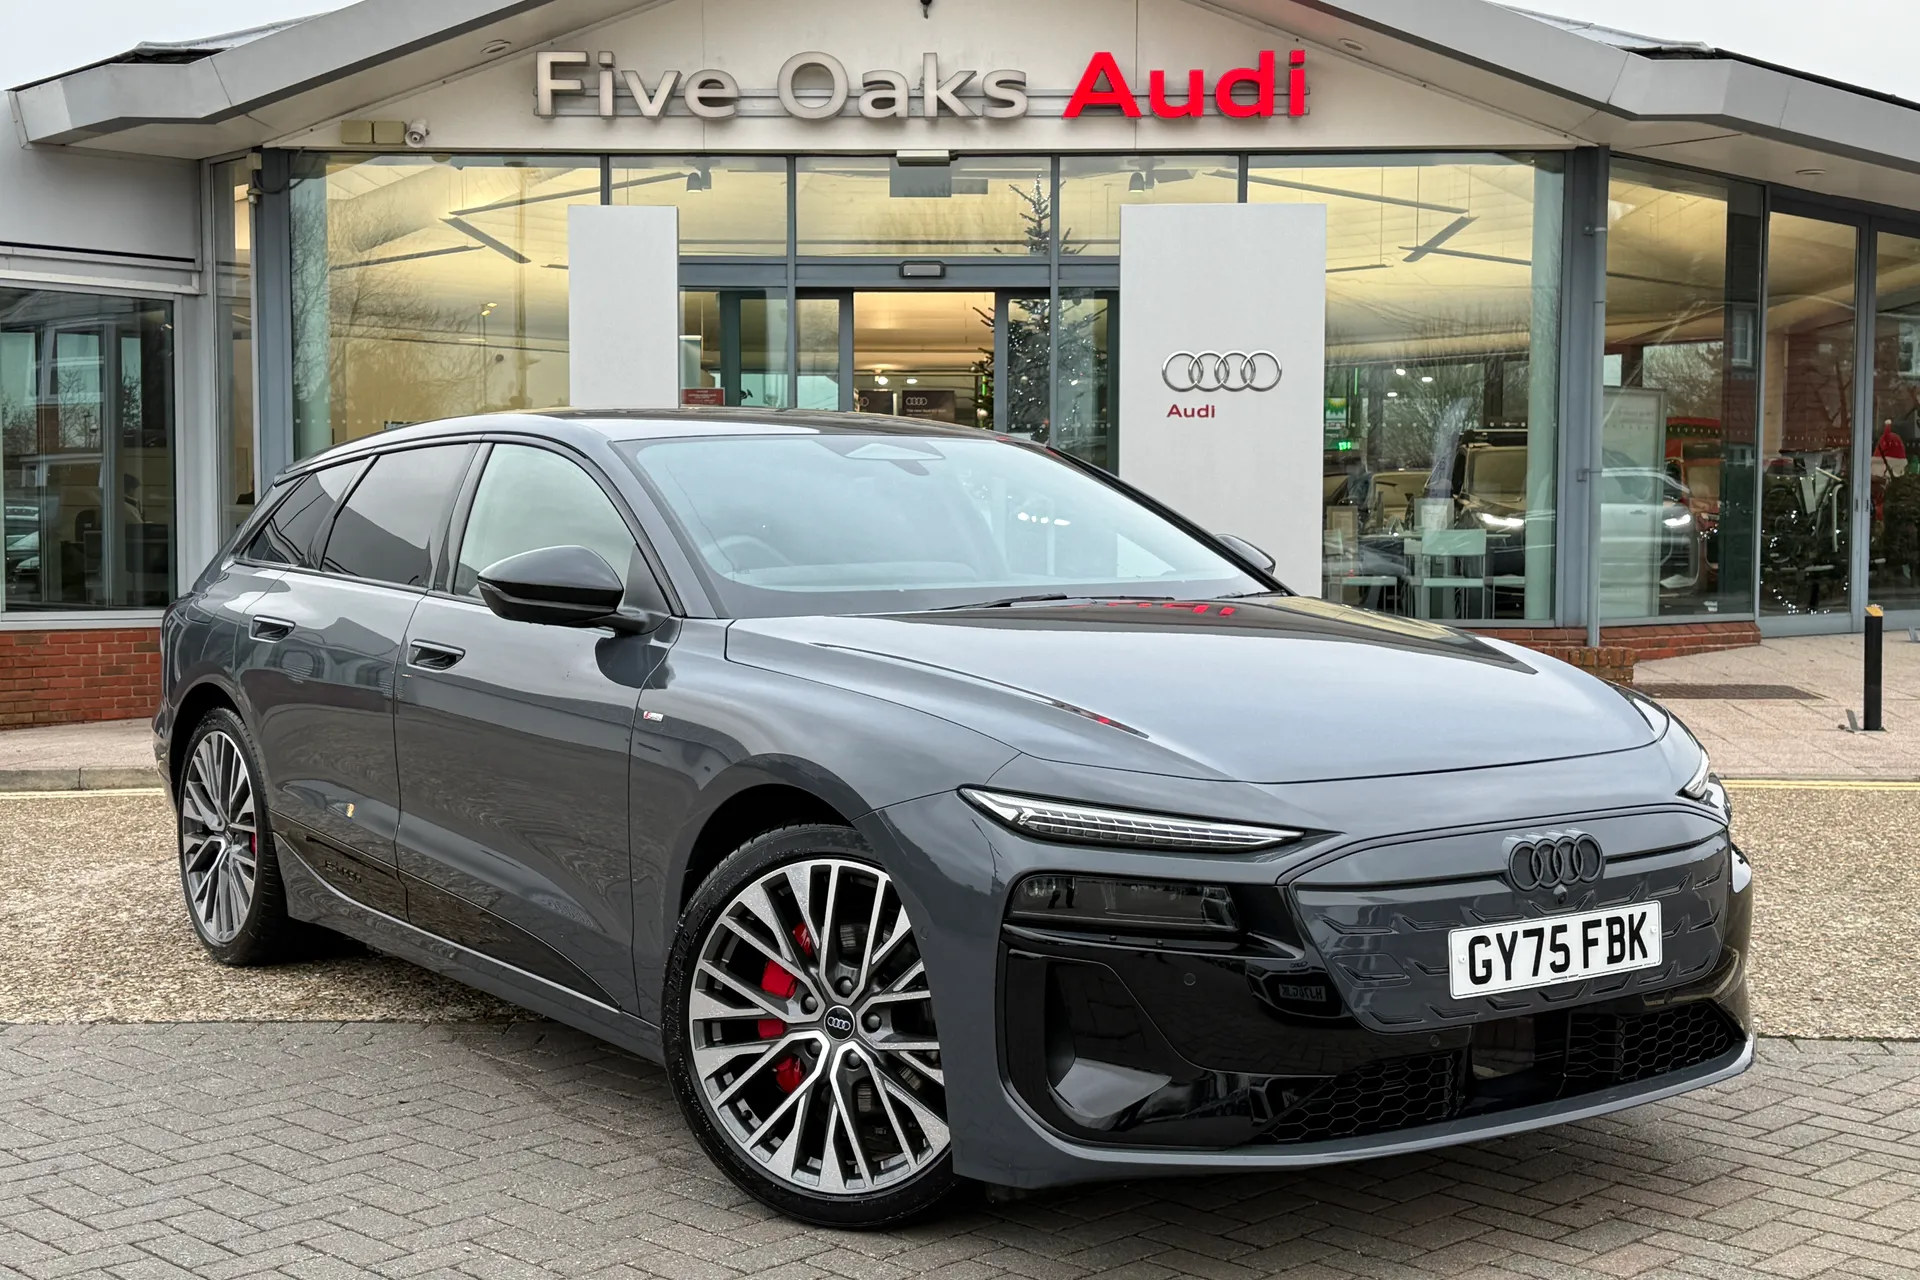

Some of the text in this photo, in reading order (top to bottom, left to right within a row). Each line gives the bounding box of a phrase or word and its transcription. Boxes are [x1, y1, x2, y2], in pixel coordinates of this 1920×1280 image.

[535, 49, 1306, 120] Five Oaks Audi
[1166, 403, 1215, 418] Audi
[1468, 911, 1648, 986] GY75 FBK
